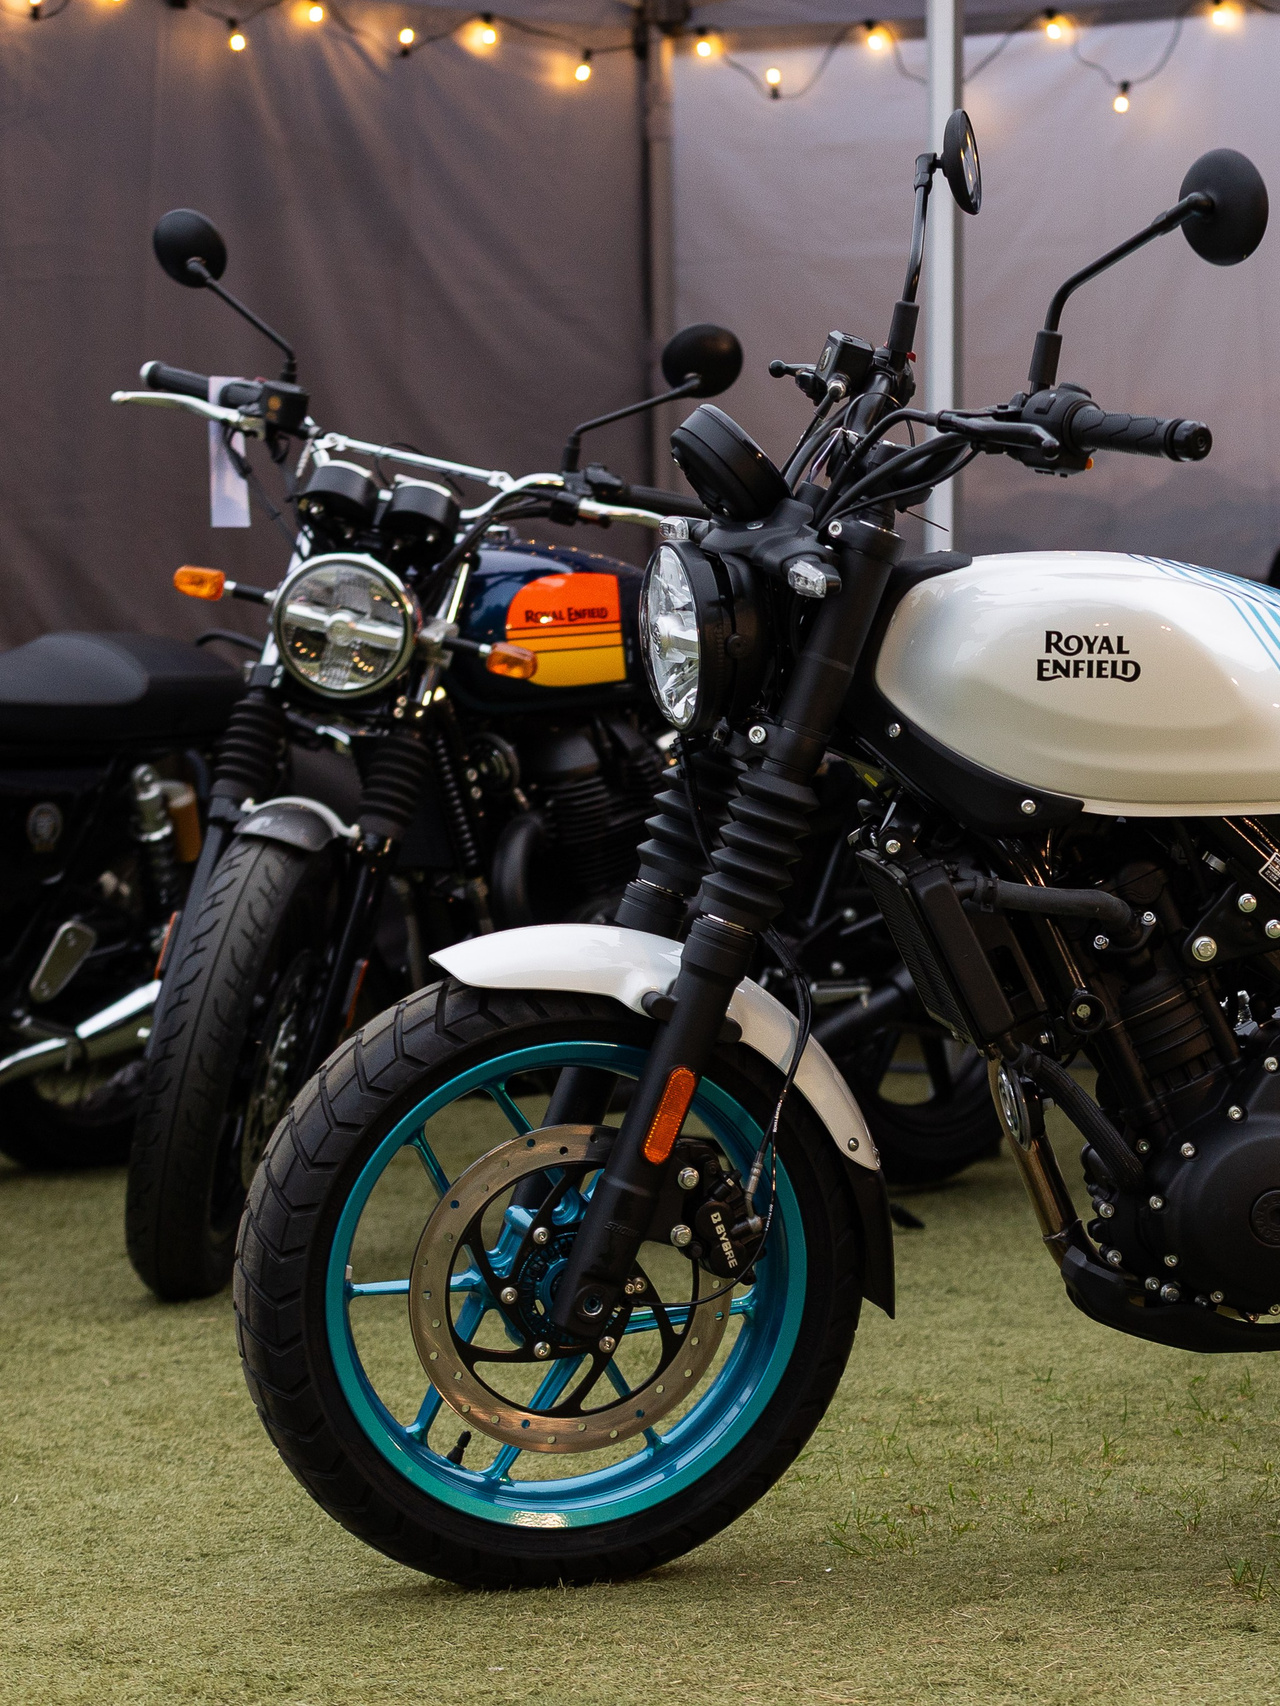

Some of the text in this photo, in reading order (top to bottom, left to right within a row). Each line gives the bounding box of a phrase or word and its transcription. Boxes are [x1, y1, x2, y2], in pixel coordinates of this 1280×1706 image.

[1045, 630, 1130, 656] ROYAL
[1037, 658, 1141, 682] ENFIELD
[715, 1223, 738, 1269] BYBRE
